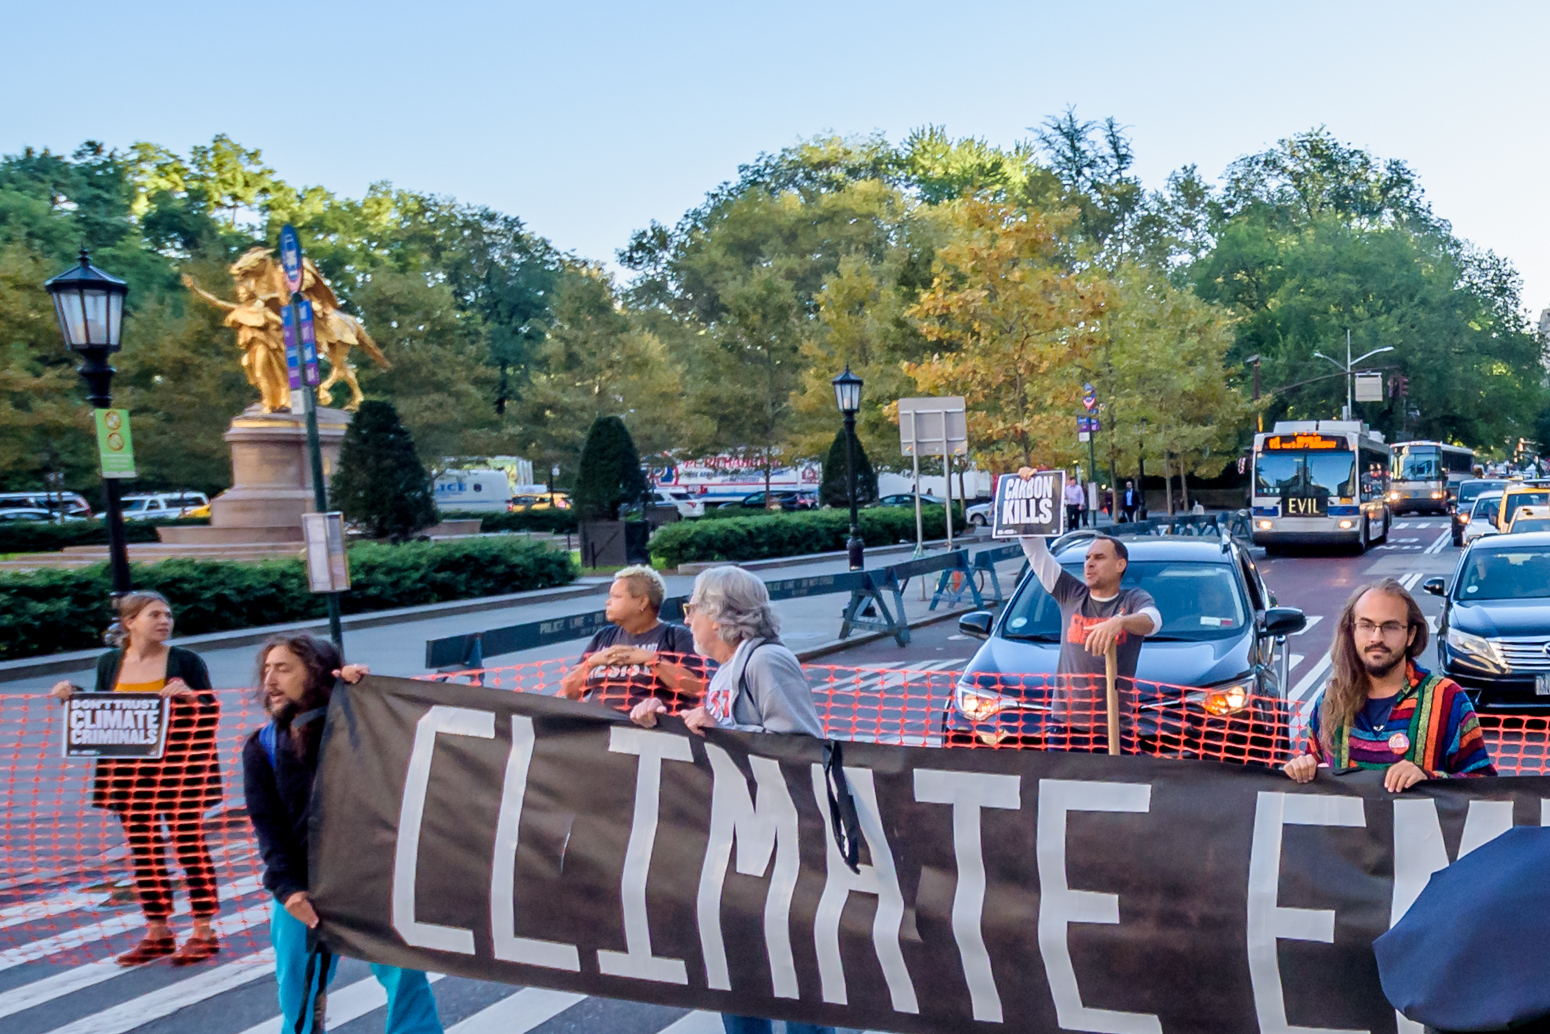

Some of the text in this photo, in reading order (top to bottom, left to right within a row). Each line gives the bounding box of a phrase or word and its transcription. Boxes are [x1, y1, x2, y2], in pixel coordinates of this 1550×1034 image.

[1004, 475, 1054, 500] CARBON
[1002, 498, 1053, 525] KILLS
[1288, 497, 1320, 514] EVIL
[71, 699, 160, 710] DON'T TRUST
[70, 709, 160, 730] CLIMATE
[70, 729, 158, 745] CRIMINALS
